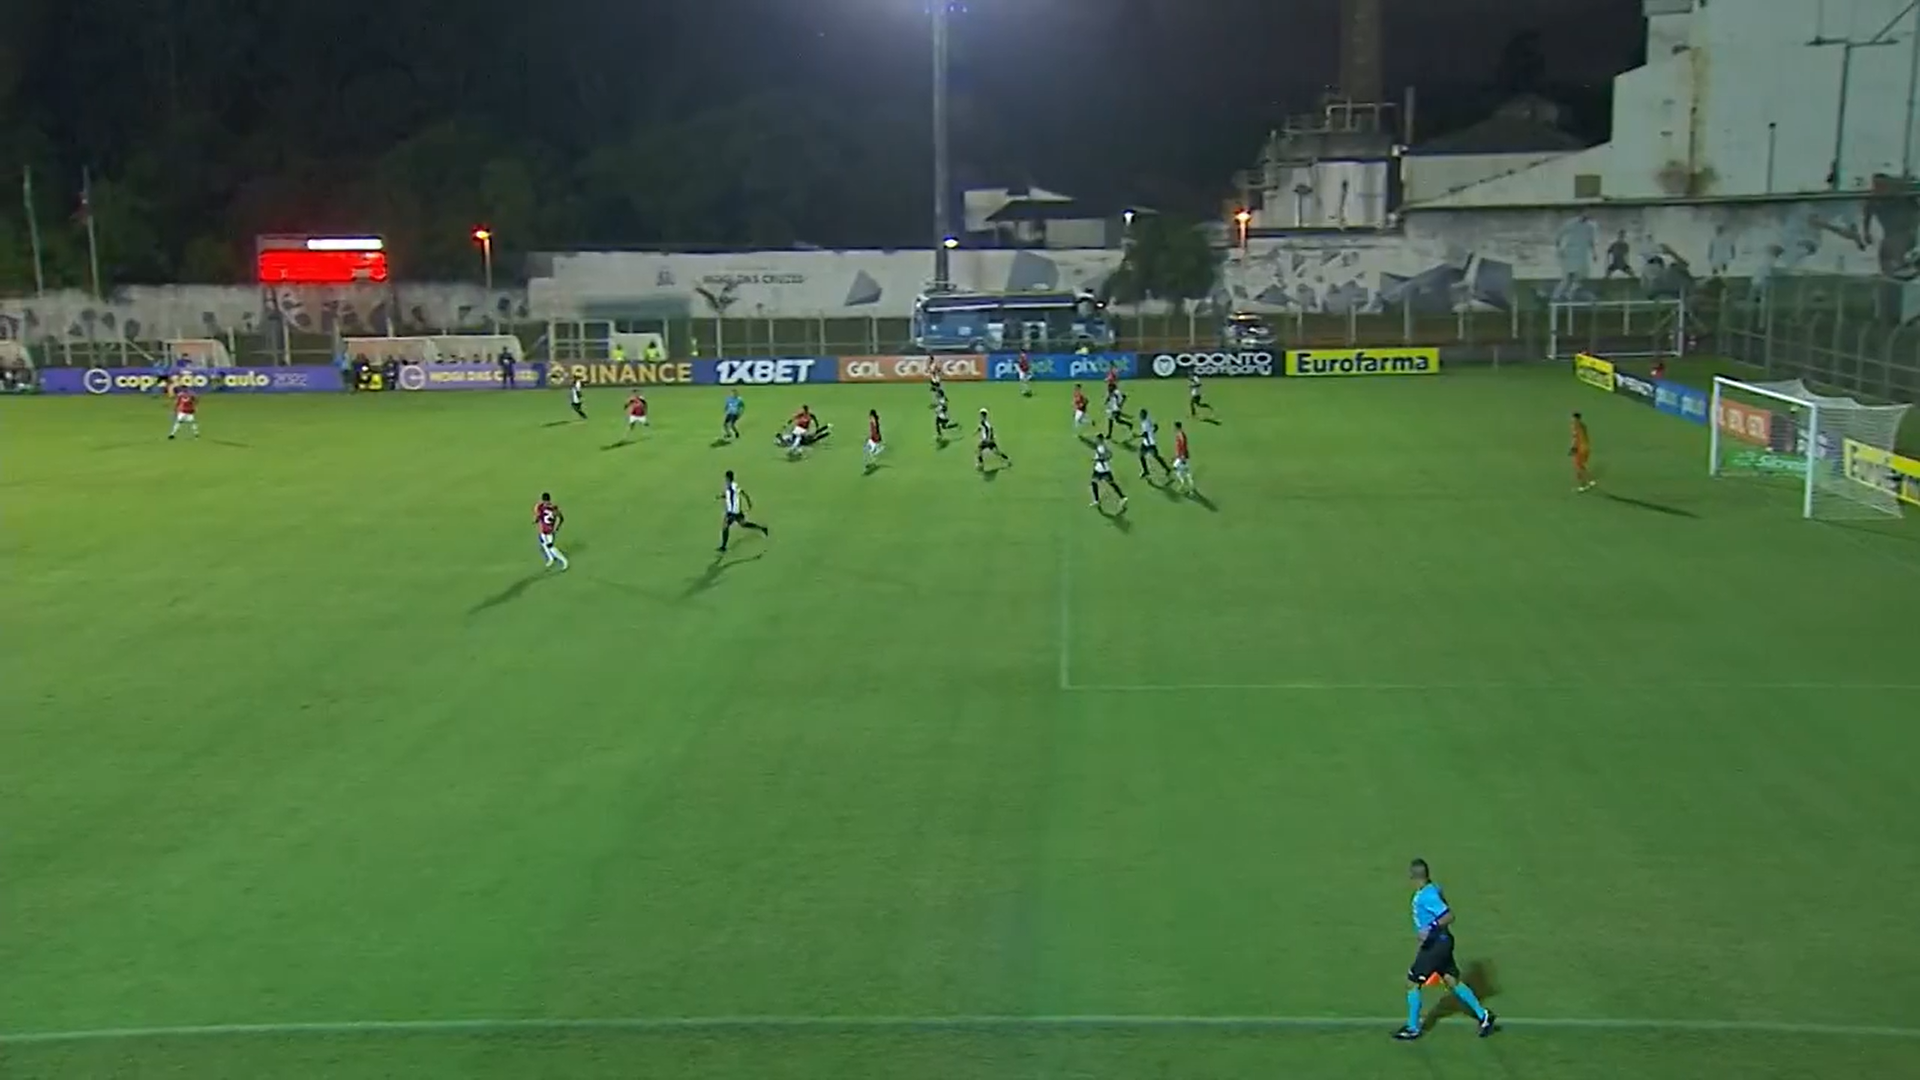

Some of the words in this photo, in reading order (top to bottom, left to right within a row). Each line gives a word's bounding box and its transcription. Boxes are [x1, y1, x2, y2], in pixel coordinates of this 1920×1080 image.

[847, 361, 884, 377] GOL
[895, 361, 932, 376] GOL
[942, 359, 981, 376] GOL
[1176, 352, 1272, 366] ODONTO
[1297, 352, 1429, 373] Eurofarma
[211, 371, 270, 387] aulo
[572, 363, 693, 383] BINANCE
[716, 360, 814, 384] 1XBET
